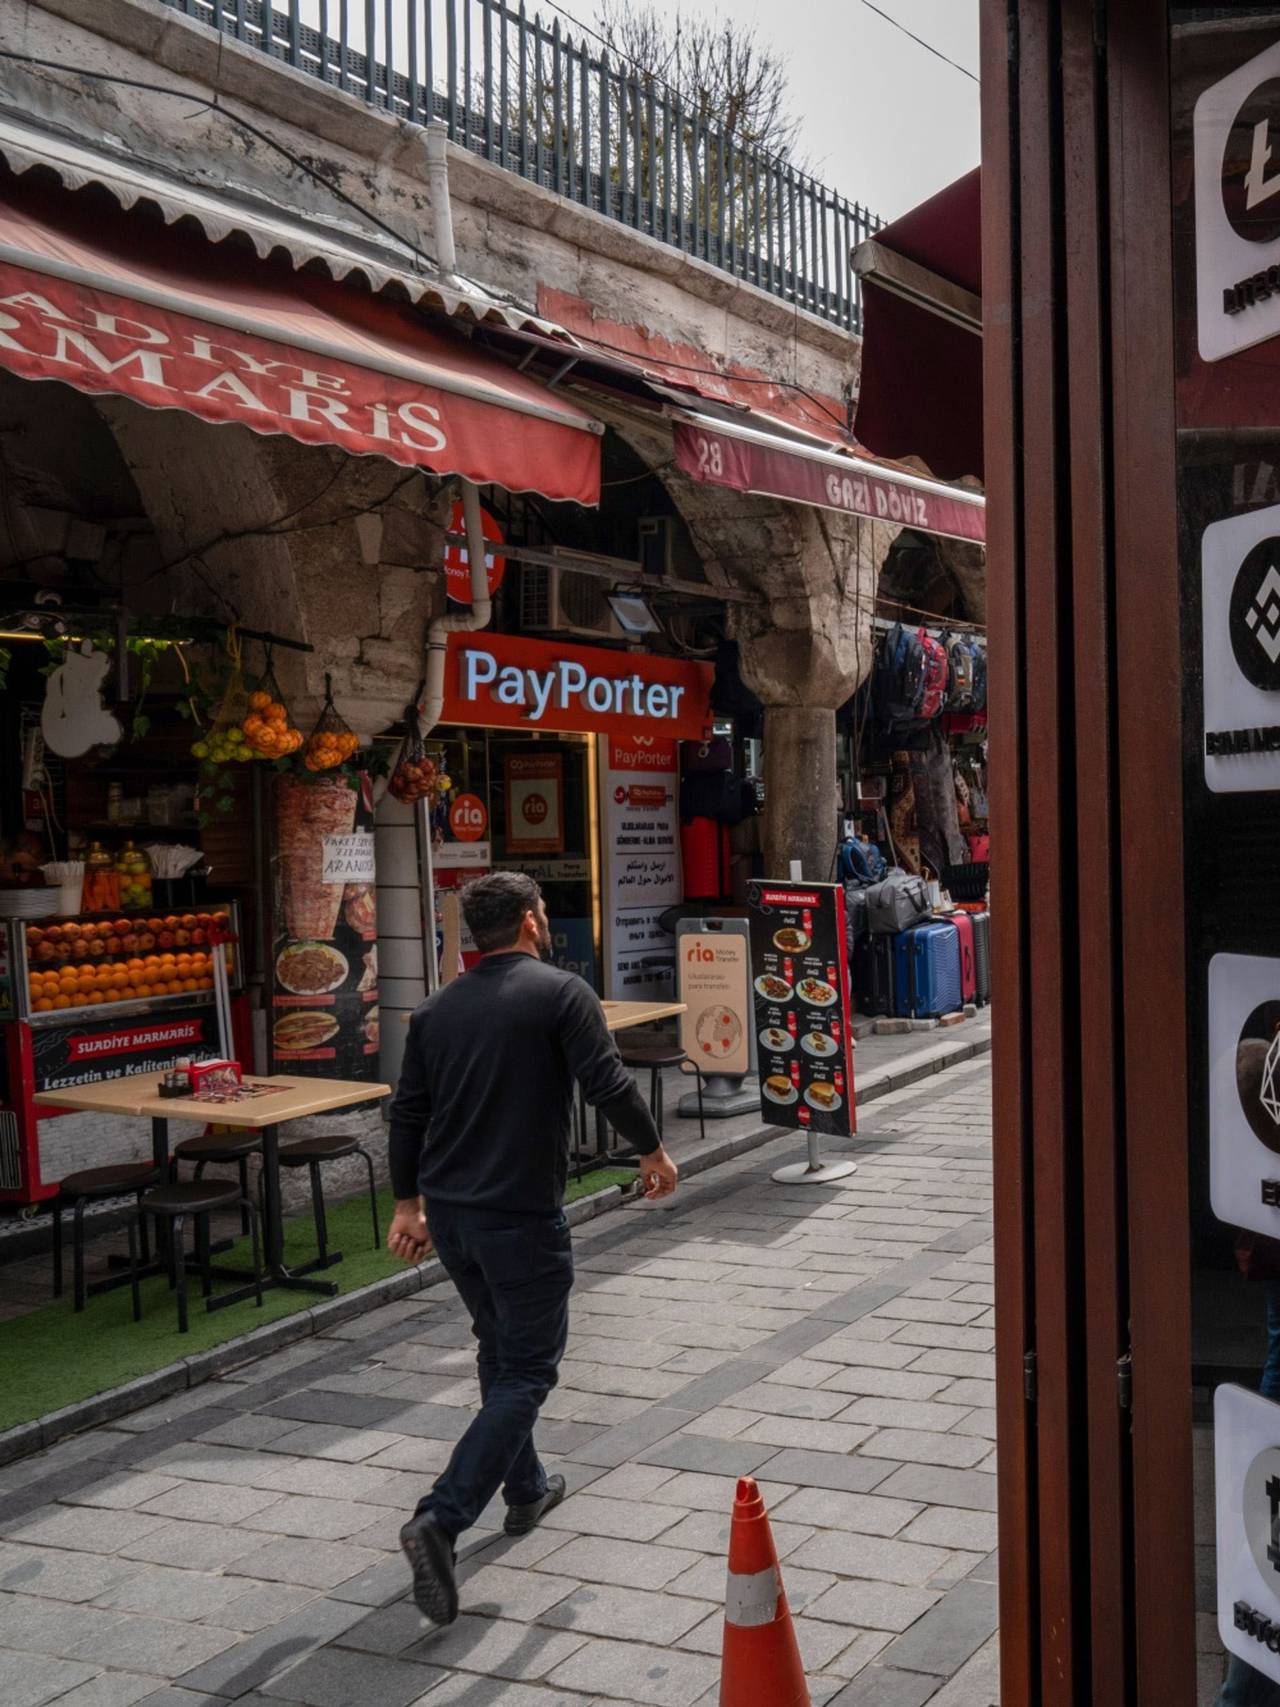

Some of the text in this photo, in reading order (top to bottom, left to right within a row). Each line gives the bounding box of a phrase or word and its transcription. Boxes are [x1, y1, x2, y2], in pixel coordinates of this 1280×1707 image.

[698, 438, 723, 476] 28
[826, 473, 929, 527] GAZİ DÖVİZ
[465, 650, 684, 720] PayPorter
[615, 749, 672, 767] PayPorter
[454, 800, 482, 825] ria
[524, 797, 545, 814] ria
[687, 942, 714, 962] ria
[78, 1025, 194, 1054] SUADİYE MARMARİS
[44, 1069, 102, 1091] Lezzetin
[106, 1067, 121, 1079] ve
[125, 1055, 178, 1077] Kaliteni
